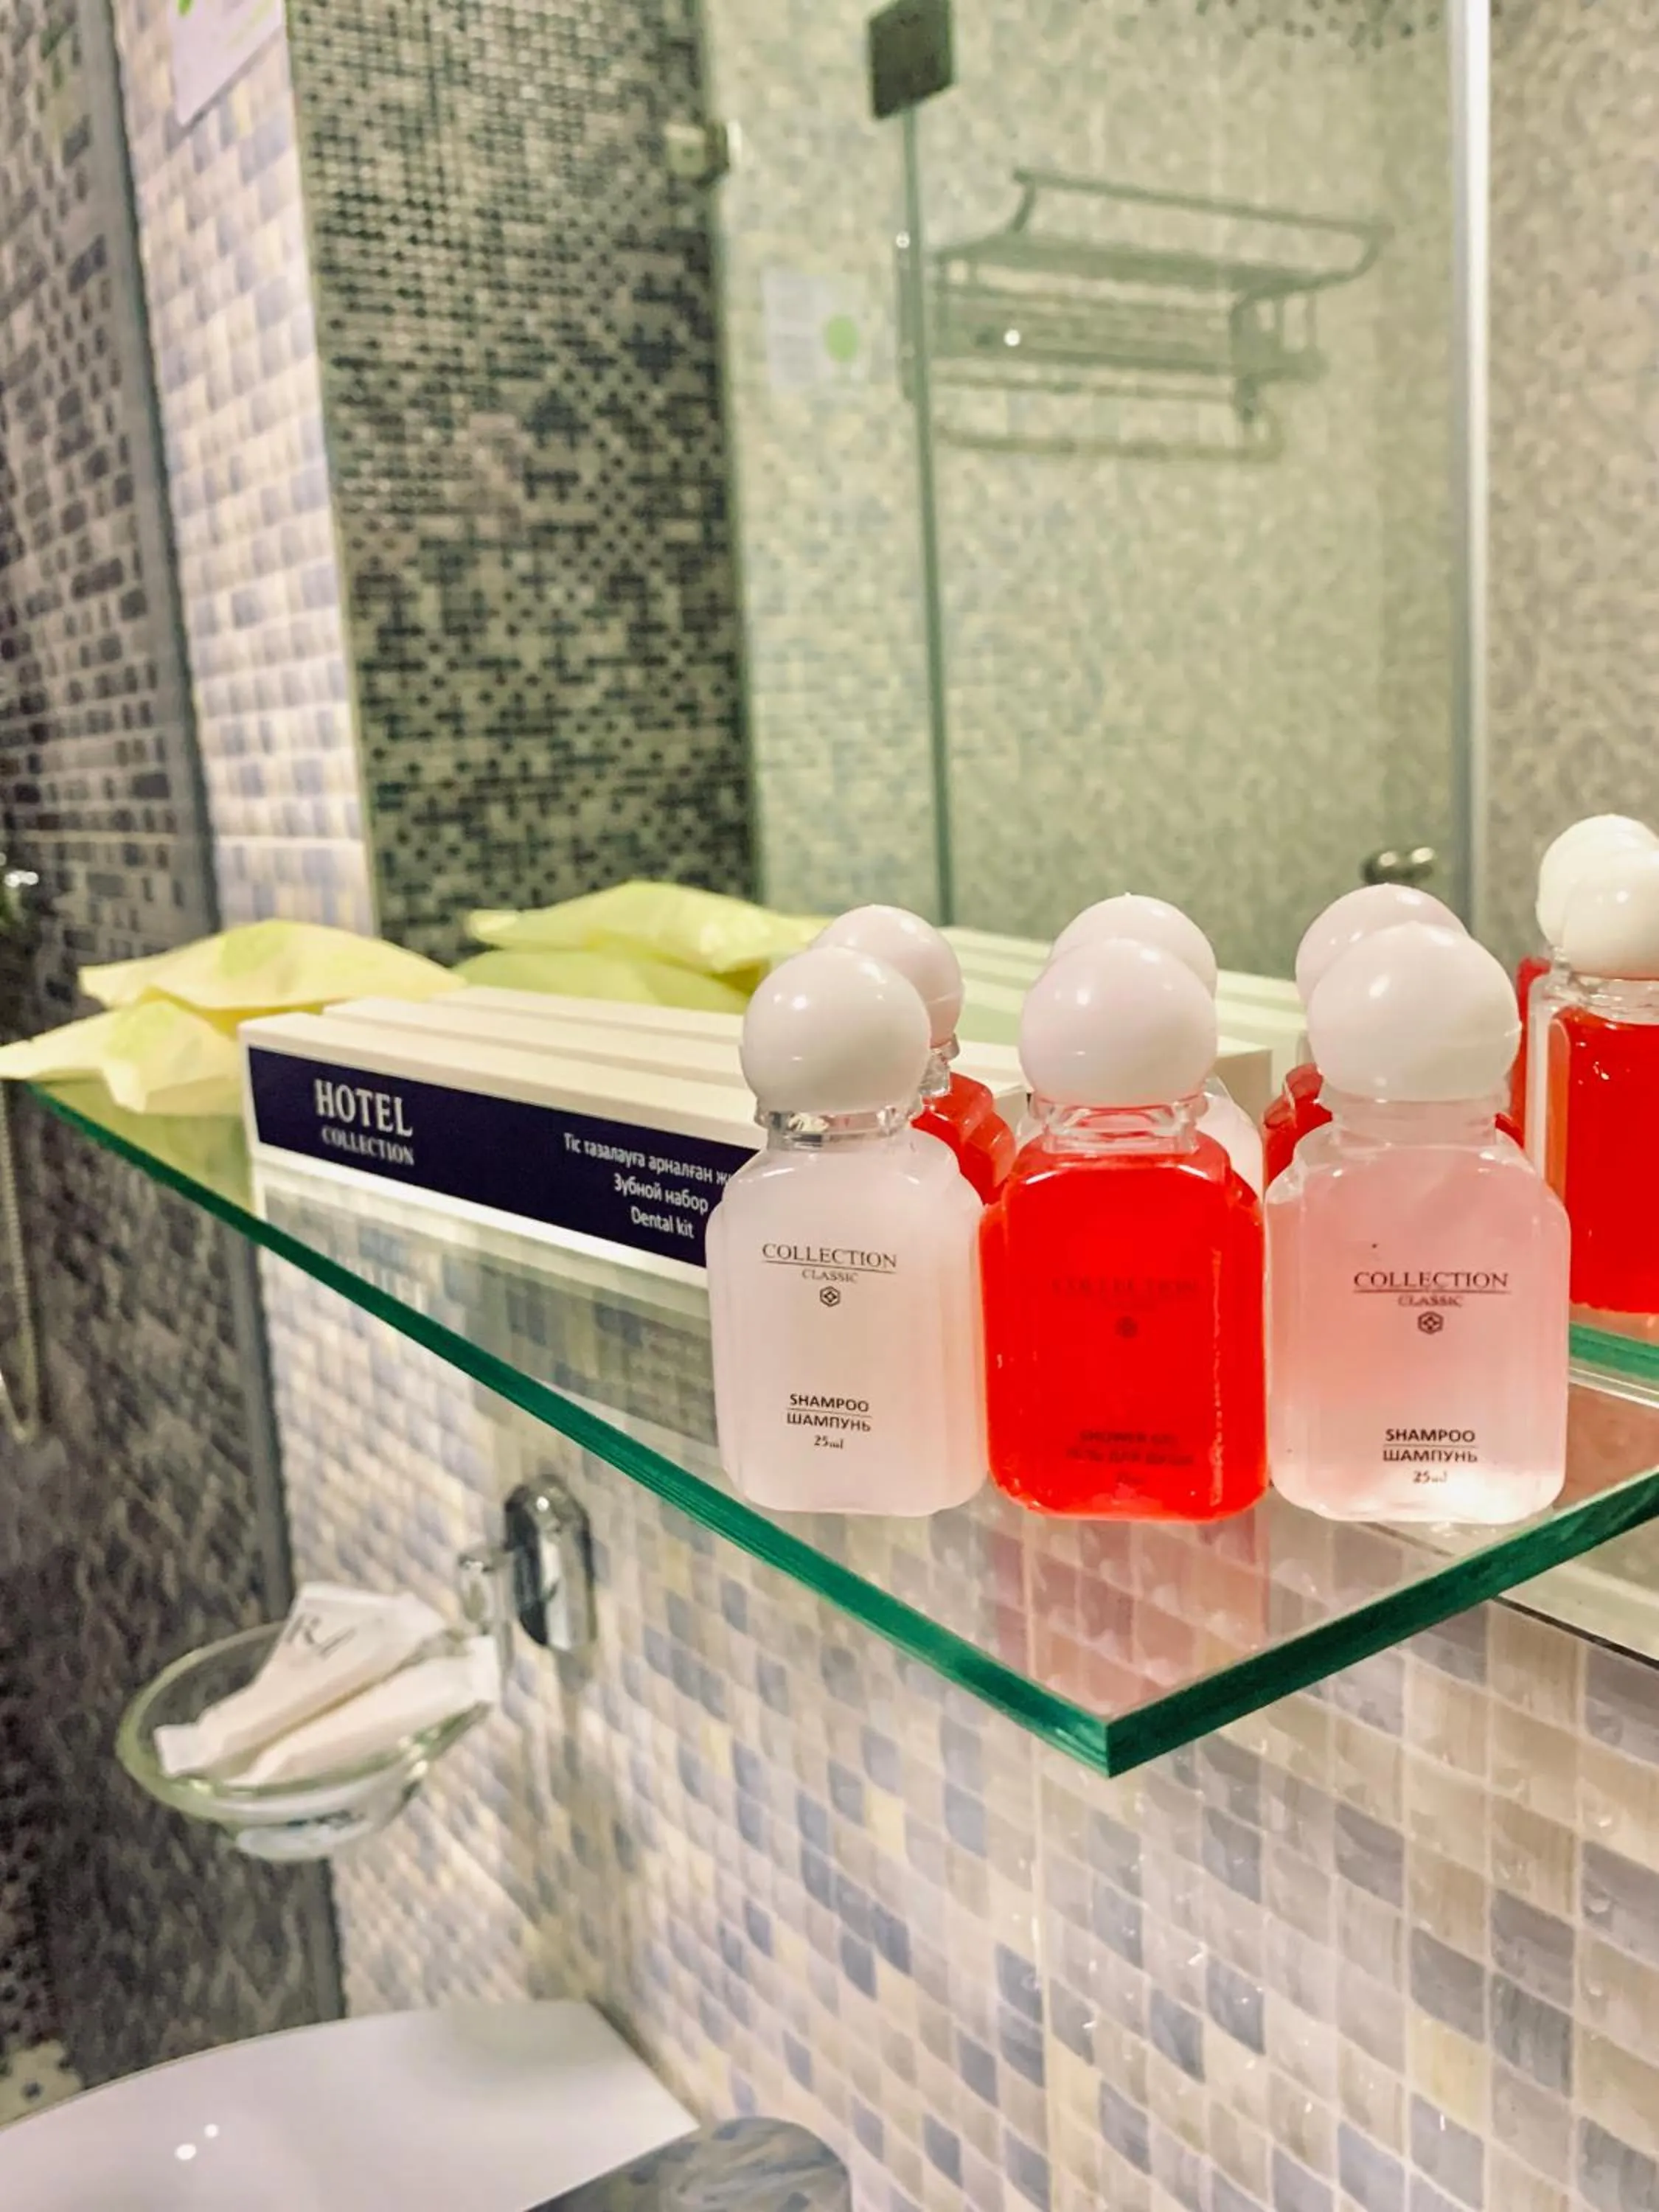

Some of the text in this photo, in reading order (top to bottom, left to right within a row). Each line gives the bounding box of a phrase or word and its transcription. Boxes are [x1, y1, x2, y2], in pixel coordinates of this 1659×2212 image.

[314, 1078, 414, 1138] HOTEL
[321, 1125, 415, 1166] COLLECTION
[613, 1173, 709, 1216] Зубной набор
[630, 1206, 695, 1239] Dental kit
[762, 1243, 897, 1270] COLLECTION
[802, 1269, 858, 1284] CLASSIC
[1354, 1271, 1509, 1289] COLLECTION
[1398, 1295, 1464, 1309] CLASSIC
[790, 1393, 870, 1413] SHAMPOO
[786, 1412, 872, 1433] ШАМПУНЬ
[813, 1435, 844, 1450] 25ml
[1385, 1428, 1477, 1444] SHAMPOO
[1382, 1449, 1478, 1464] ШАМПУНЬ
